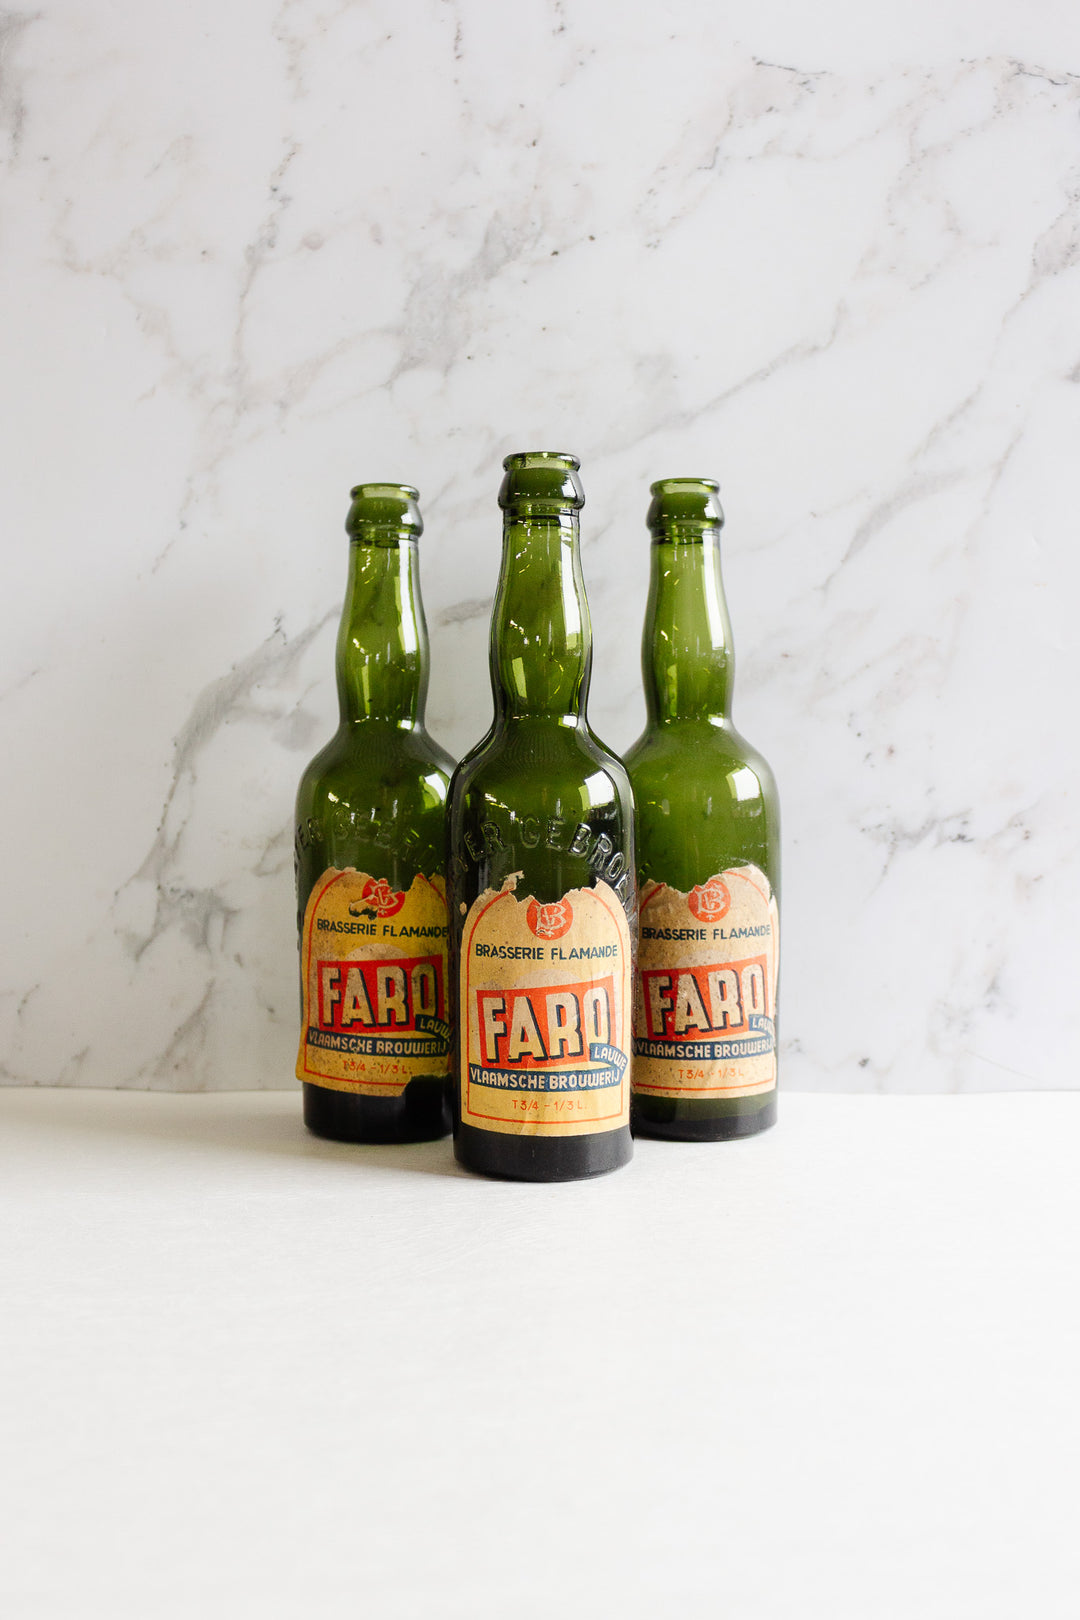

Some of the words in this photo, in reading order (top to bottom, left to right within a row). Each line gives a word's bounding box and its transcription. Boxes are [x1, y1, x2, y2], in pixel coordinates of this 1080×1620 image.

[317, 919, 376, 935] BRASSERIE
[383, 925, 449, 937] FLAMANDE
[642, 927, 706, 940] BRASSERIE
[713, 924, 771, 940] FLAMANDE
[475, 943, 544, 960] BRASSERIE
[551, 945, 618, 960] FLAMANDE
[322, 964, 438, 1027] FARO
[648, 964, 766, 1036] FARO
[482, 986, 611, 1063] FARO
[309, 1030, 372, 1053] VLAAMSCHE
[376, 1041, 446, 1055] BROUWERIJ
[638, 1041, 711, 1058] VLAAMSCHE
[594, 1046, 626, 1070] LAUWE
[470, 1066, 545, 1089] VLAAMSCHE
[550, 1069, 620, 1090] BROUWERIJ
